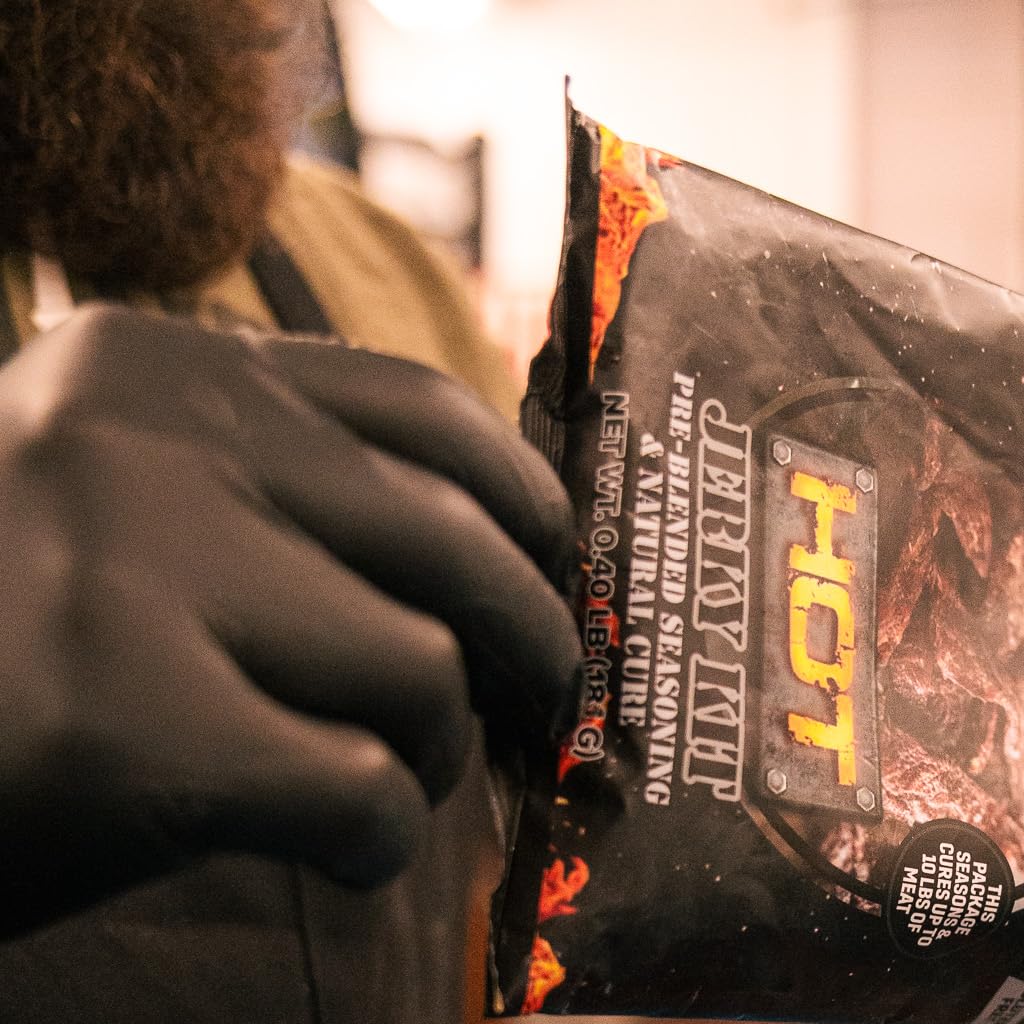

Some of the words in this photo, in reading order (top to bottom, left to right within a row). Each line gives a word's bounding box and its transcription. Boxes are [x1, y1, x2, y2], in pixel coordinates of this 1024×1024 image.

[600, 392, 630, 459] NET
[638, 432, 665, 458] &
[592, 456, 625, 523] WT.
[660, 371, 701, 604] PRE-BLENDED
[625, 470, 664, 625] NATURAL
[691, 398, 753, 652] JERKY
[584, 523, 620, 606] 0.40
[584, 607, 613, 650] LB
[788, 471, 858, 786] HOT
[618, 635, 652, 727] CURE
[644, 612, 684, 806] SEASONING
[573, 726, 605, 761] G)
[681, 652, 746, 803] KIT
[896, 866, 919, 915] MEAT
[915, 877, 934, 910] LBS
[921, 853, 936, 873] 10
[934, 842, 954, 901] CURES
[943, 851, 971, 927] SEASONS
[907, 912, 926, 934] OF
[928, 902, 947, 926] UP
[955, 861, 987, 936] PACKAGE
[980, 884, 1002, 923] THIS
[917, 927, 936, 948] TO
[935, 928, 951, 940] &
